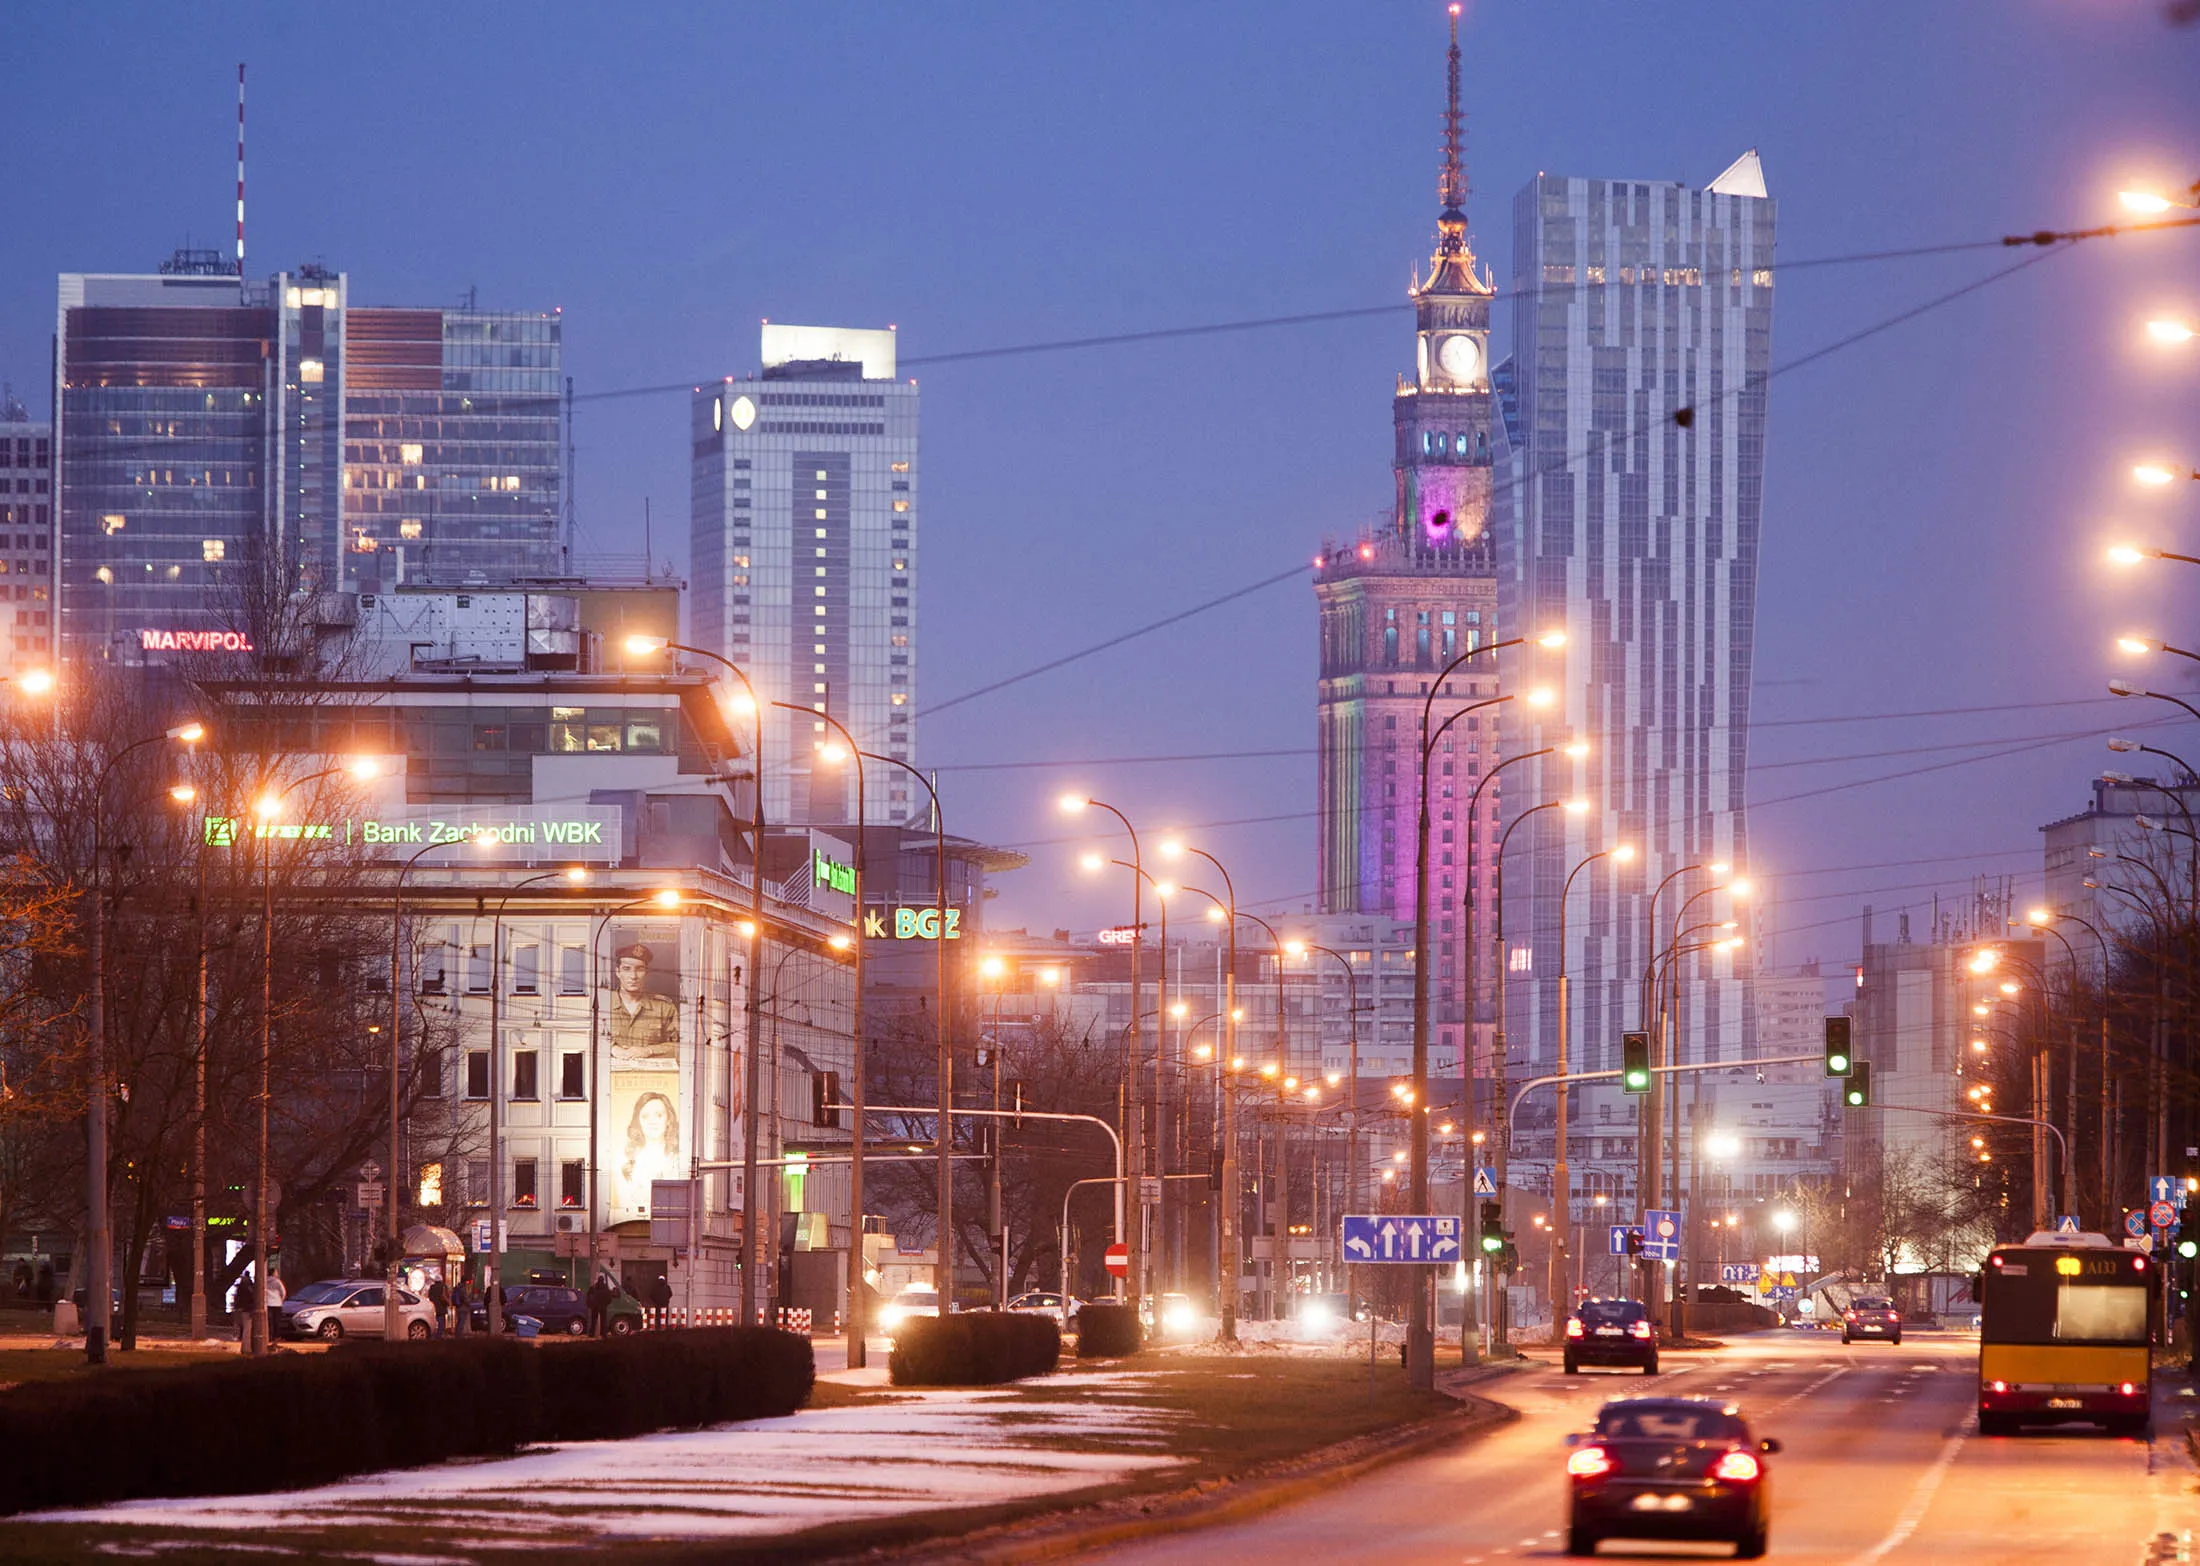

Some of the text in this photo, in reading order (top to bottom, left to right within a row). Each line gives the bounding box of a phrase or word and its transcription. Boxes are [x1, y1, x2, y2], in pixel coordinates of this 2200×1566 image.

[142, 630, 254, 651] MARVIPOL
[363, 821, 602, 844] Bank Zachodni WBK
